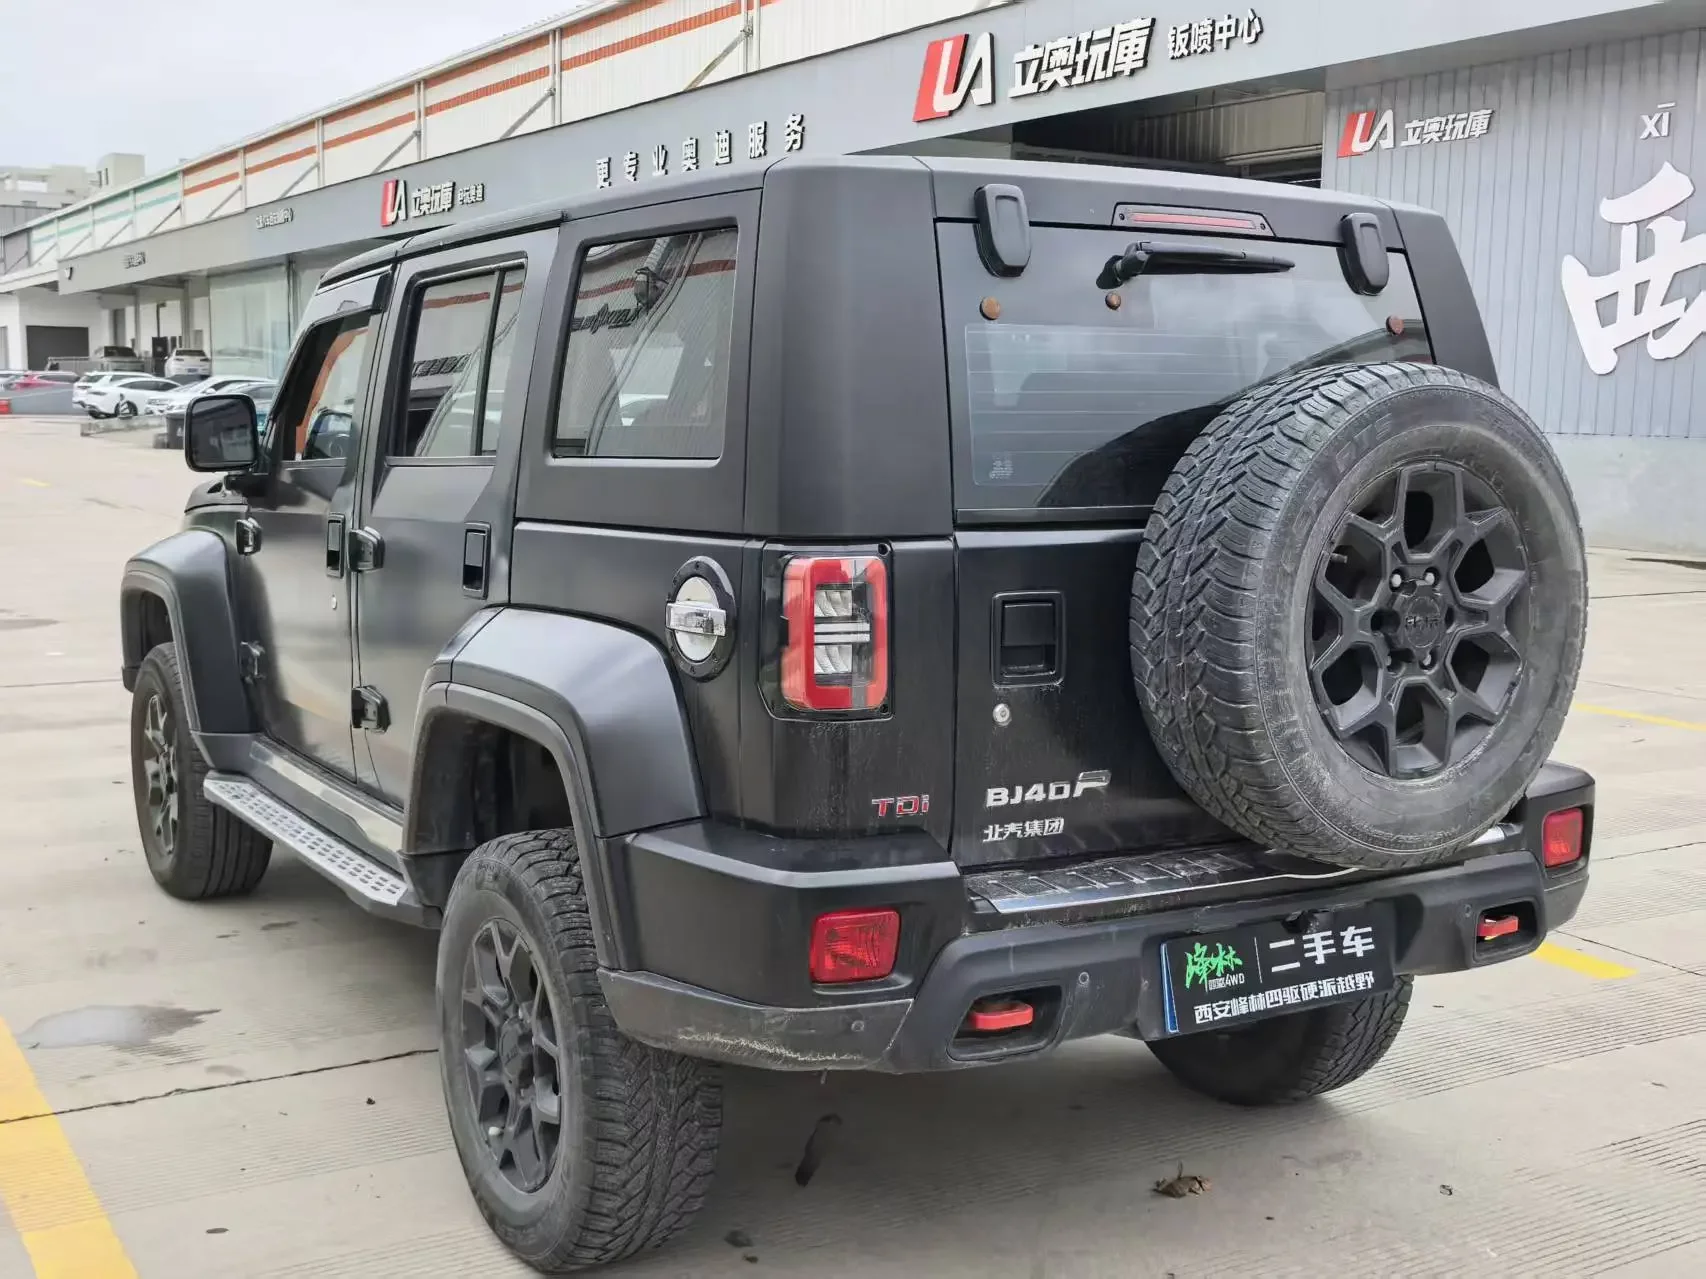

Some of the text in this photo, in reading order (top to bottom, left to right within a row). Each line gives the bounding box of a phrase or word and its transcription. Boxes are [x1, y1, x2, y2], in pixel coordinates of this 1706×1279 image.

[1167, 9, 1265, 60] 钣喷中心
[596, 113, 805, 189] 更专业奥迪服务
[982, 816, 1065, 843] 北汽集团
[1269, 925, 1375, 973] 二手车
[1193, 970, 1375, 1025] 西安峰林四驱硬派越野
